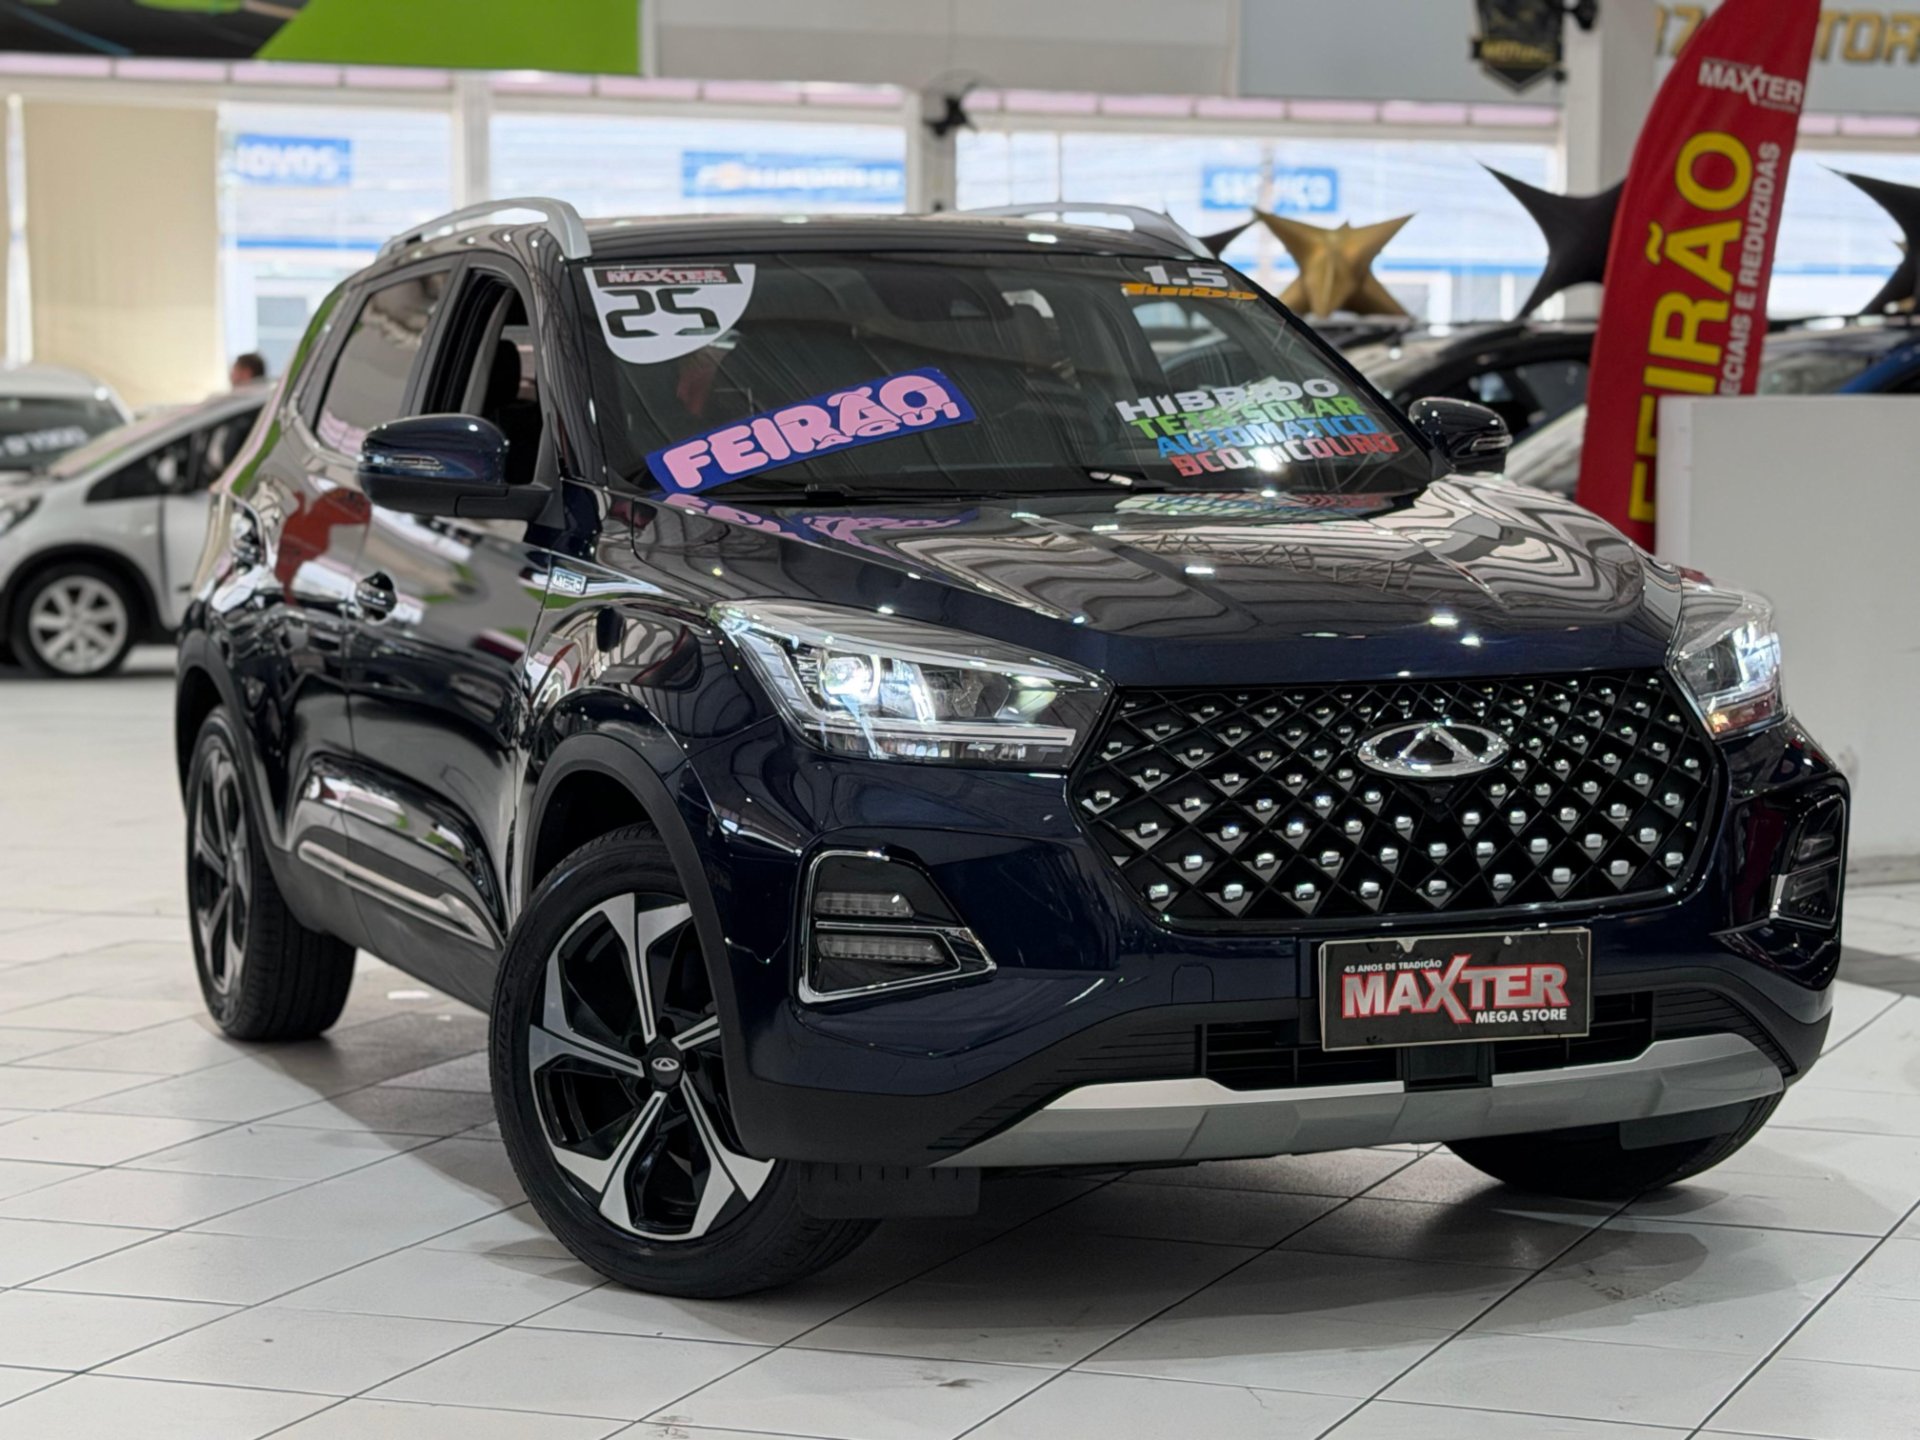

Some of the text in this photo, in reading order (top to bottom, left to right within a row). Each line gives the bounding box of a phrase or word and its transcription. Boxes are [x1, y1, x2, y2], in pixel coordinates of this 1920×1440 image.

[1698, 61, 1804, 106] MAXTER
[1737, 141, 1781, 288] REDUZIDAS
[606, 269, 728, 284] MAXTER
[1143, 264, 1229, 288] 1.5
[602, 287, 722, 339] 25
[1628, 131, 1753, 523] IRÃO
[662, 375, 952, 489] FEIRÃO
[1242, 396, 1365, 425] SOLAR
[1342, 953, 1572, 1024] MAXTER
[1344, 958, 1443, 974] 45 ANOS DE TRADIÇÃO
[1475, 1008, 1568, 1025] MEGA STORE
